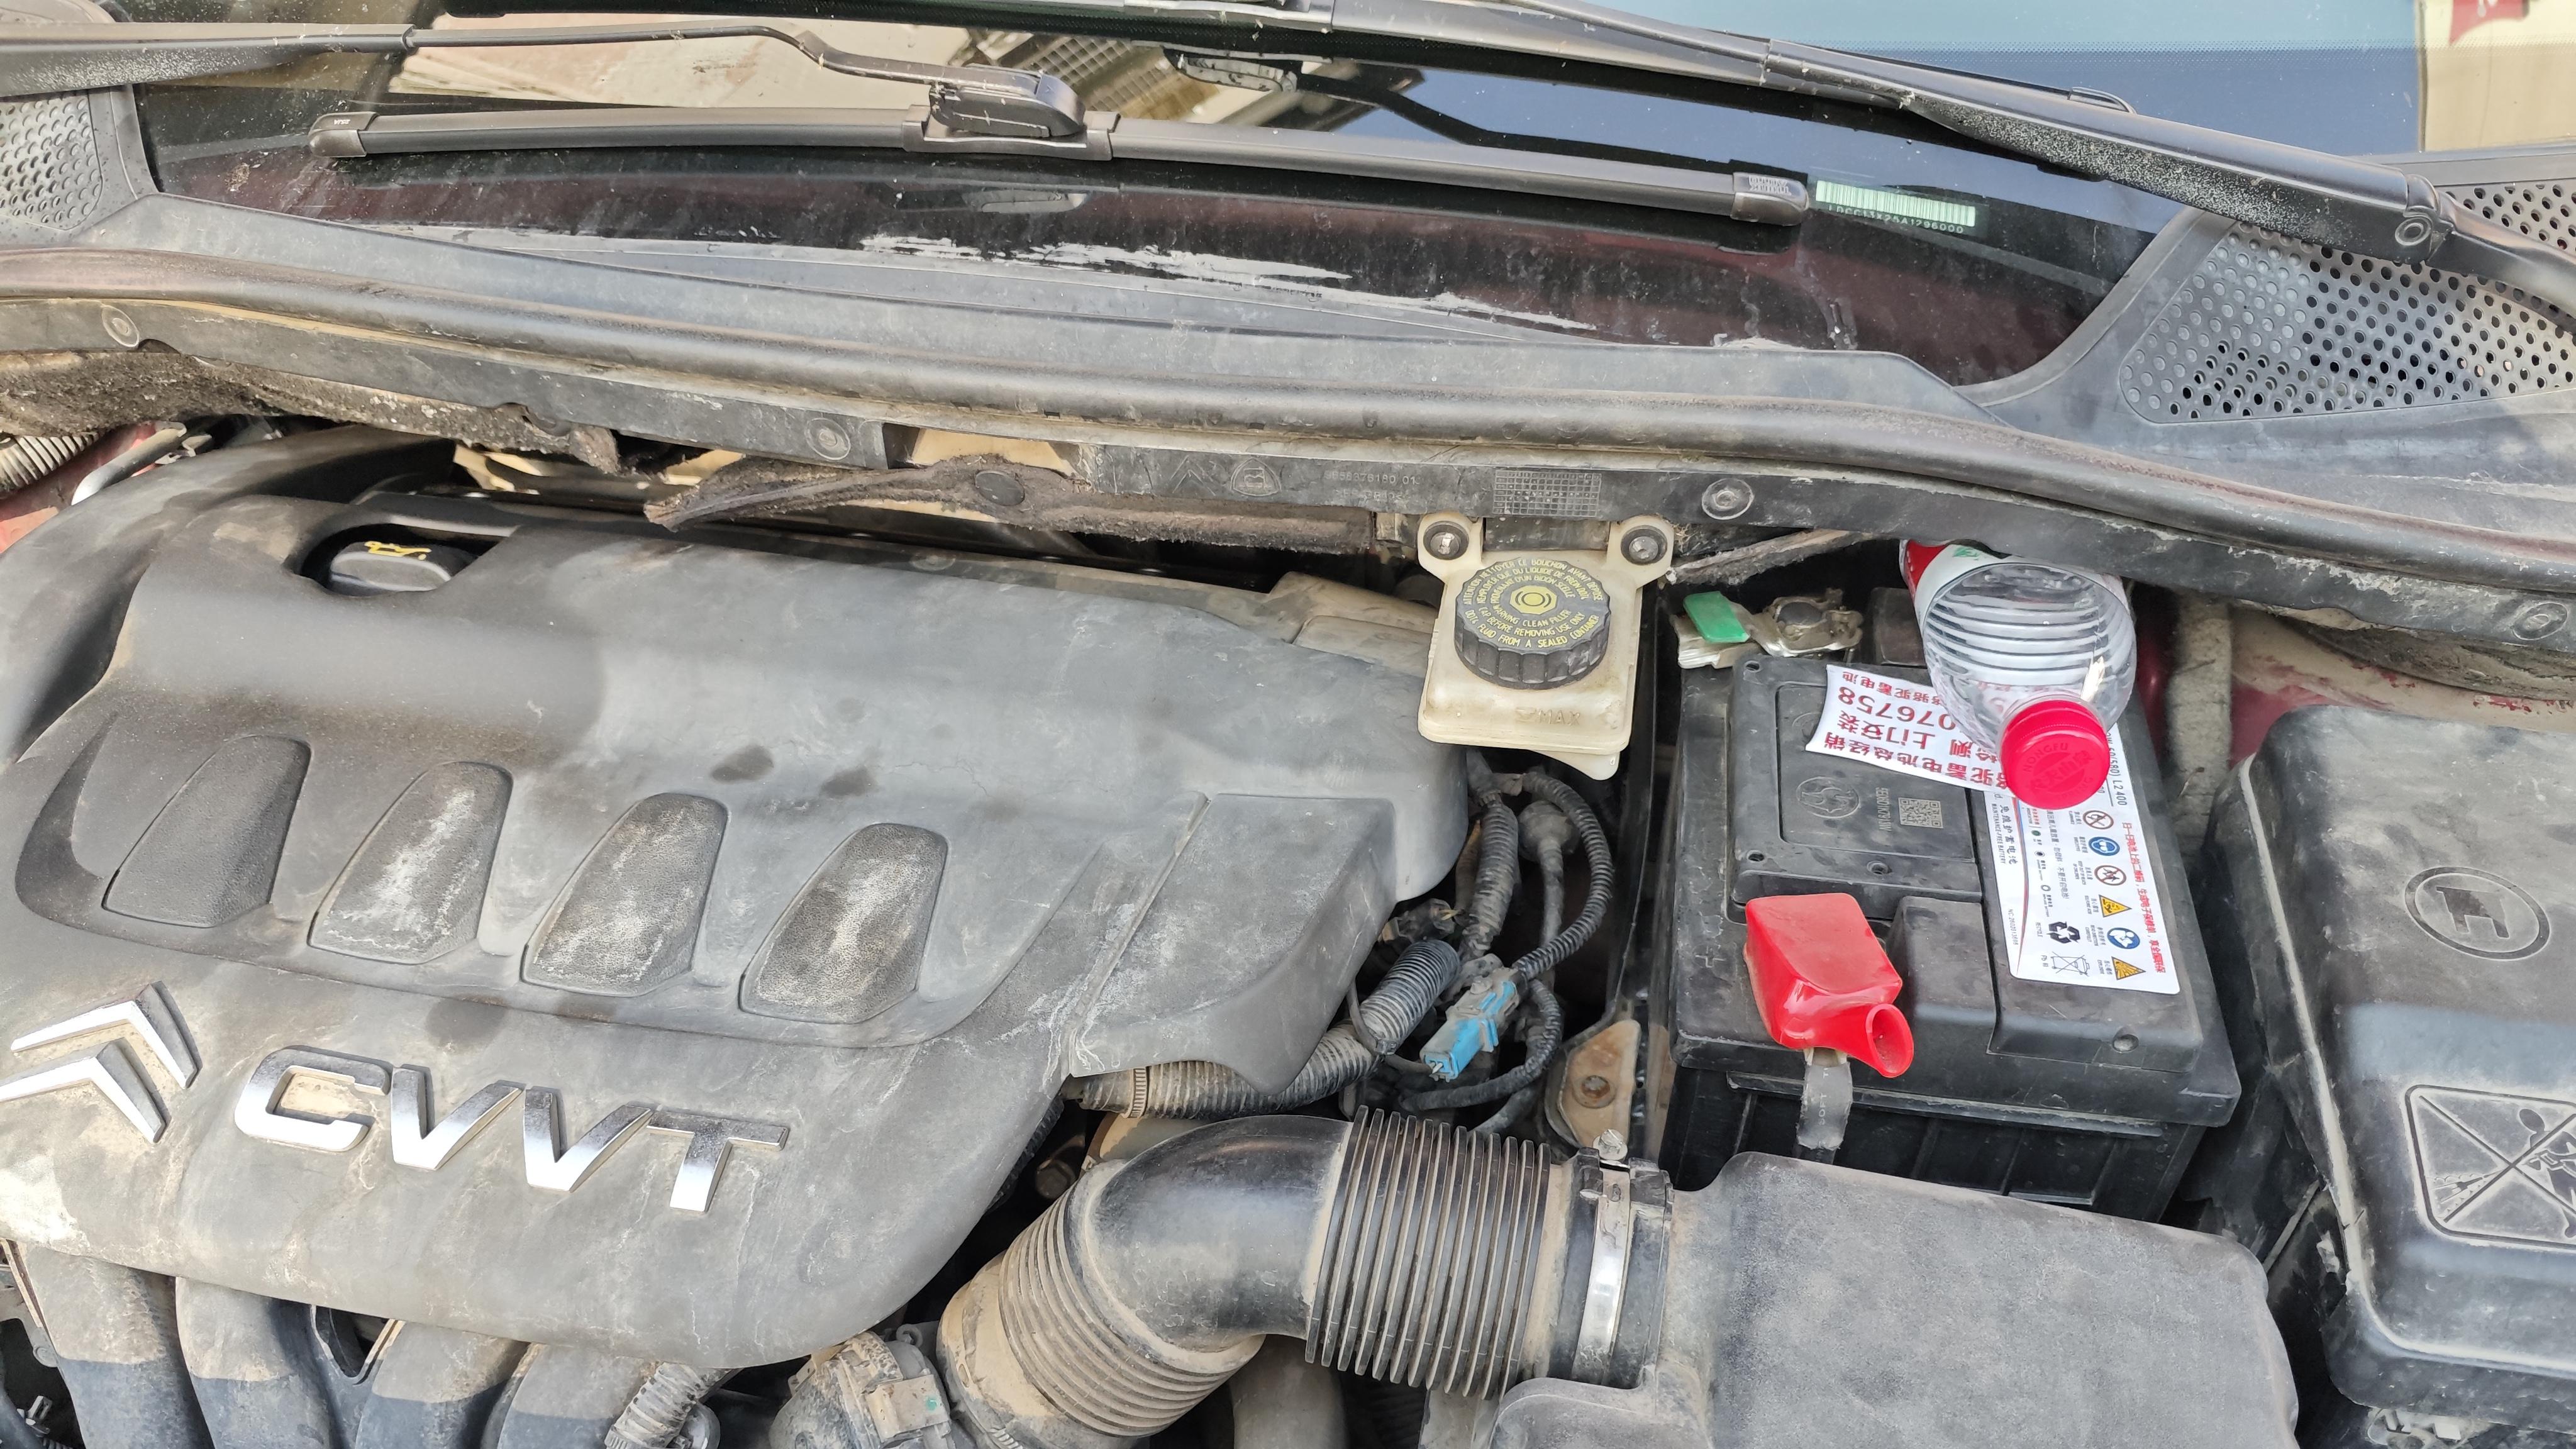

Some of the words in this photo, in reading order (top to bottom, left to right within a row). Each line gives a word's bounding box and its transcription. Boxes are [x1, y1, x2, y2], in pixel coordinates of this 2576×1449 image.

[1567, 567, 1592, 582] AVANT
[1477, 624, 1497, 639] FLUID
[1497, 634, 1521, 647] FROM
[1524, 638, 1532, 648] A
[1537, 635, 1568, 648] SEALED
[1568, 614, 1601, 640] CONTAINER
[1478, 606, 1492, 620] CAP
[1487, 617, 1511, 633] BEFORE
[1514, 628, 1557, 638] REMOVING
[1556, 623, 1572, 634] USE
[1570, 611, 1586, 626] ONLY
[1492, 603, 1520, 625] WARNING
[1522, 619, 1549, 628] CLEAN
[1548, 609, 1572, 625] FILLER
[1539, 709, 1581, 726] MAX
[1838, 686, 1957, 731] 076758
[1837, 709, 1936, 750] 上门安装
[2023, 742, 2069, 773] NONGFU
[1997, 845, 2006, 864] BATTERY
[233, 1044, 791, 1214] CVVT
